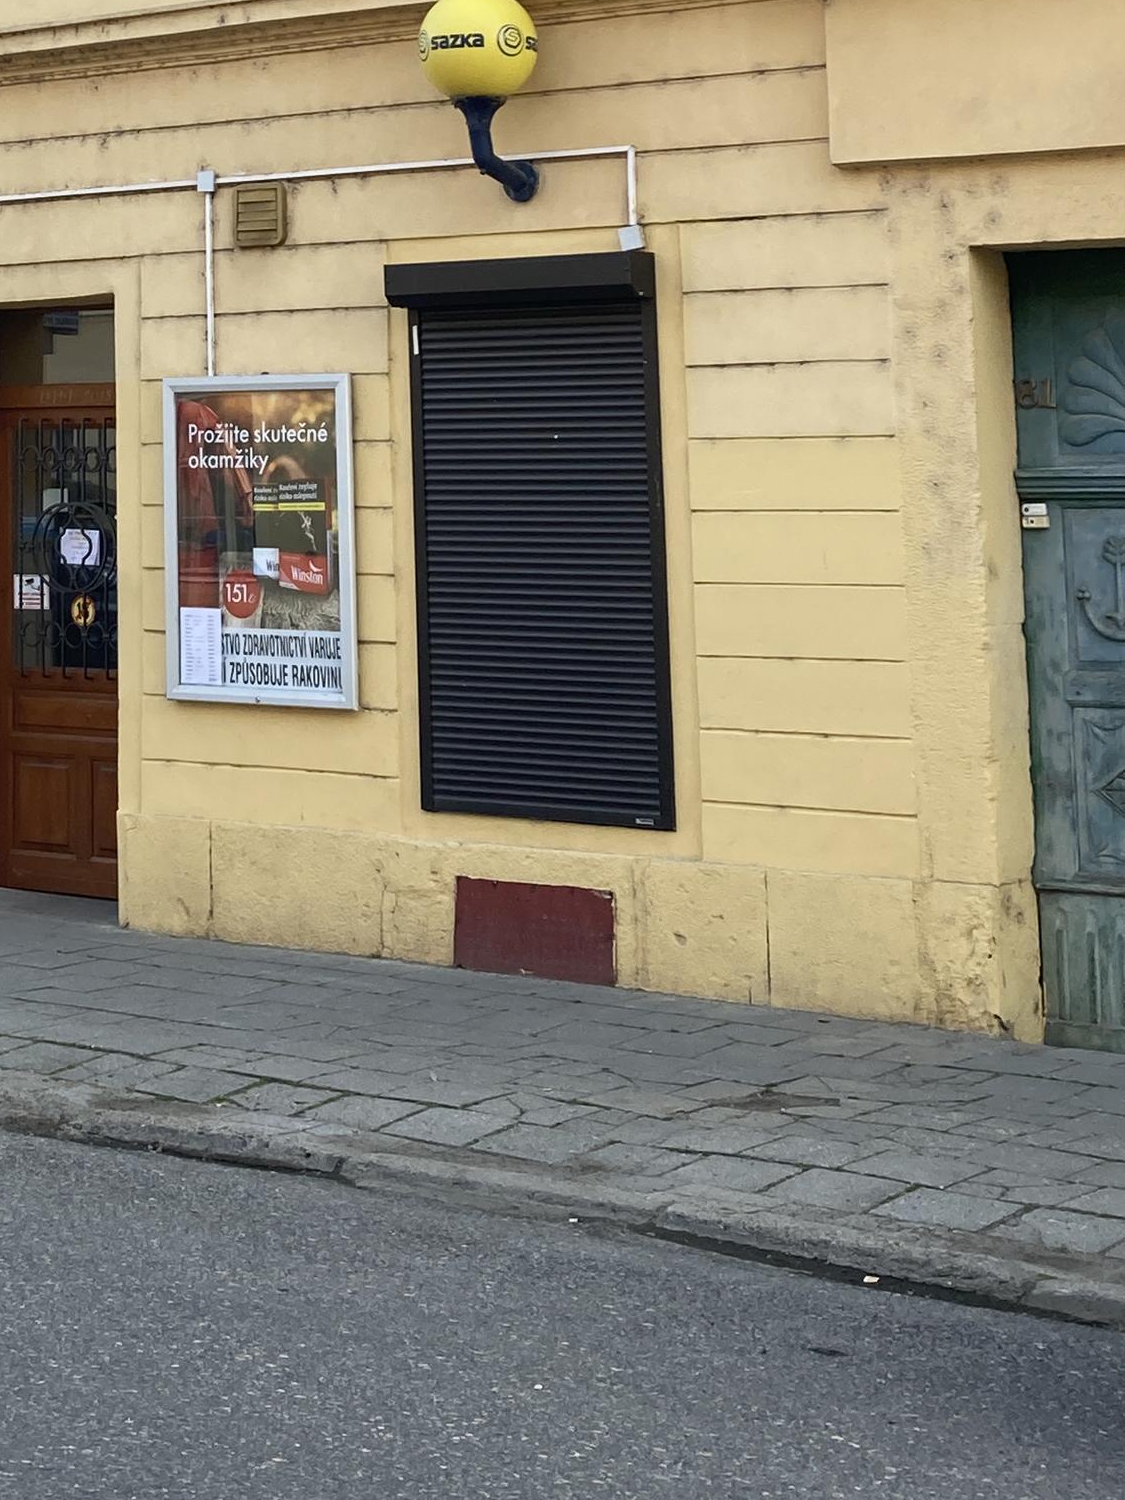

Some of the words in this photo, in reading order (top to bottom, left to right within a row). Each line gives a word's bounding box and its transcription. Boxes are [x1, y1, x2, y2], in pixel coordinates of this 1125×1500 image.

[431, 32, 485, 51] sazka
[188, 422, 250, 448] Prožijte
[254, 420, 328, 443] skutečné
[188, 447, 269, 475] okamžiky
[290, 564, 324, 586] Winston
[225, 583, 247, 603] 151
[242, 631, 307, 658] ZDRAVOTNICTVÍ
[308, 636, 342, 660] VARUJE
[229, 656, 289, 687] ZPŮSOBUJE
